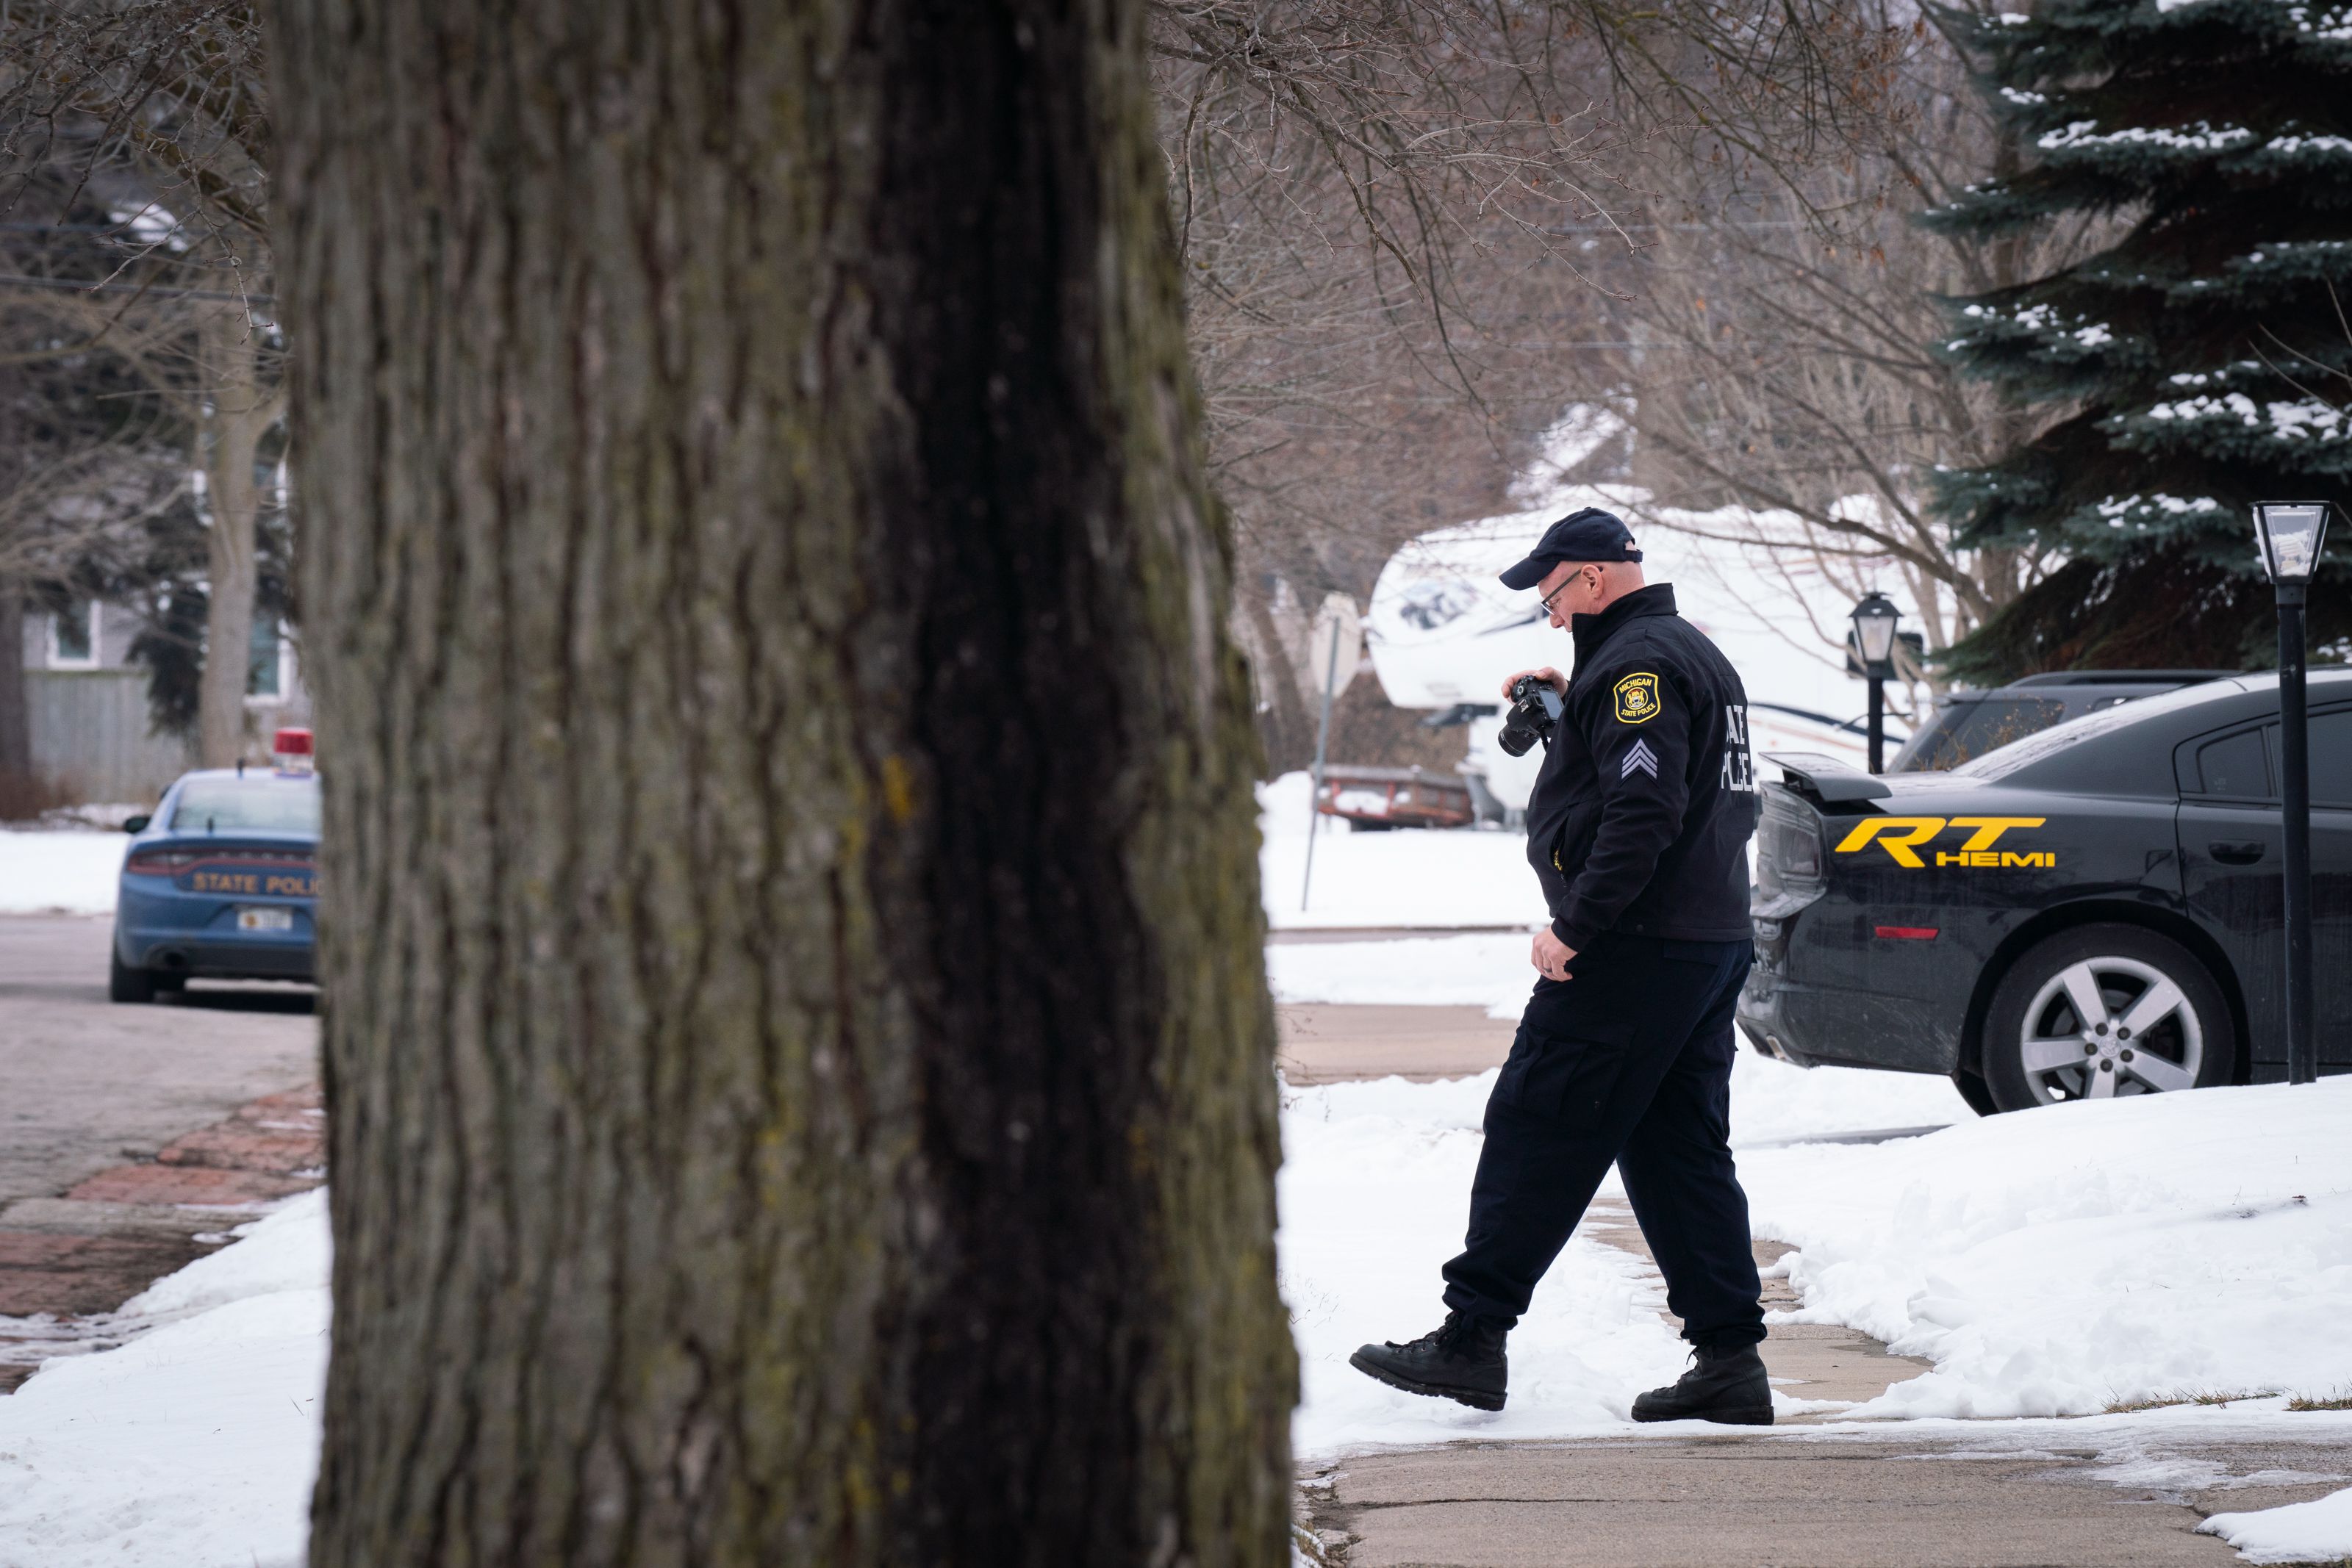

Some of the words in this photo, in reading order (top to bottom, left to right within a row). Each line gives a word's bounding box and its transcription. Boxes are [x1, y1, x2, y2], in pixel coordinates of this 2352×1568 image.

[1619, 678, 1652, 694] MICHIGAN
[1621, 709, 1637, 717] STATE
[1637, 702, 1656, 716] POLICE
[1835, 817, 2047, 868] RT
[1936, 852, 2055, 867] HEMI
[193, 872, 257, 893] STATE
[266, 875, 321, 896] POLI
